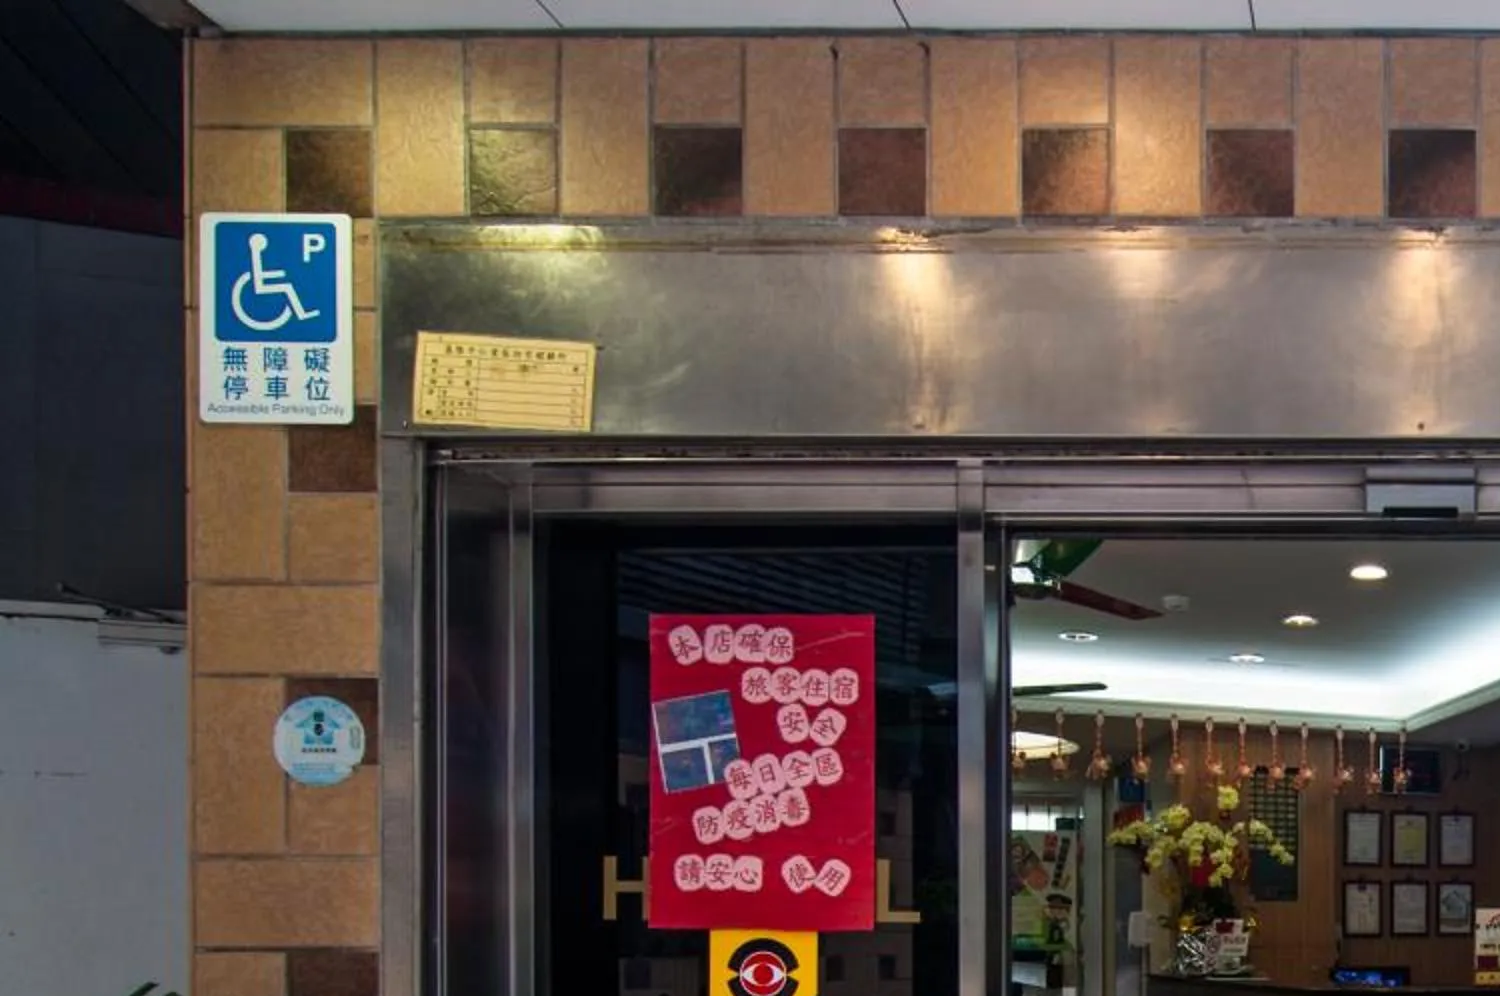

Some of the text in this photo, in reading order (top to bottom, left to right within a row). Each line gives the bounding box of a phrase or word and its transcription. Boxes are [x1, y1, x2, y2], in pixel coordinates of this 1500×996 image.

[302, 233, 326, 263] P
[222, 346, 331, 373] 無障礙
[223, 376, 331, 401] 停車位
[207, 403, 345, 417] Accessible Parking Only
[675, 629, 793, 661] 本店確保
[744, 671, 855, 701] 旅客住宿
[782, 711, 838, 739] 安全
[728, 752, 840, 790] 每日全區
[696, 796, 809, 836] 防疫消毒
[678, 859, 758, 886] 請安心
